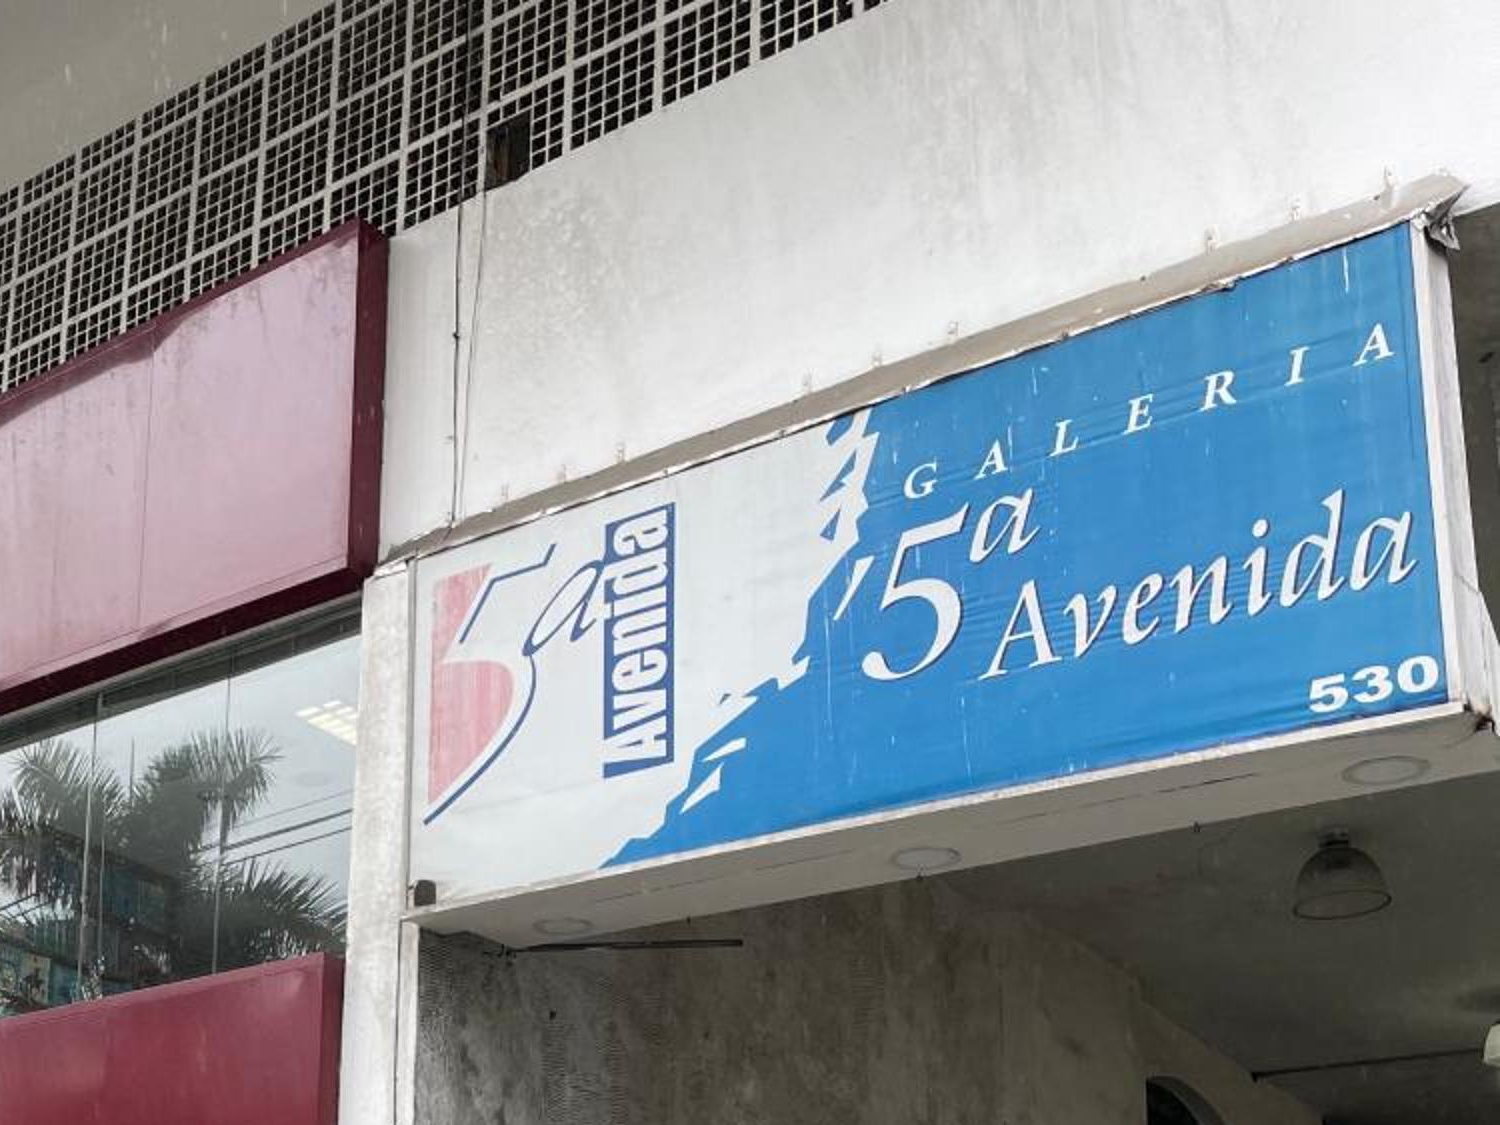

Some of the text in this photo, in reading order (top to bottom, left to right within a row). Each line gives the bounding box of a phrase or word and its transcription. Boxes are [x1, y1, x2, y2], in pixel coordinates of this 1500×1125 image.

[903, 322, 1394, 500] GALERIA
[604, 507, 670, 768] Avenida
[978, 489, 1419, 681] Avenida
[1308, 655, 1439, 713] 530
